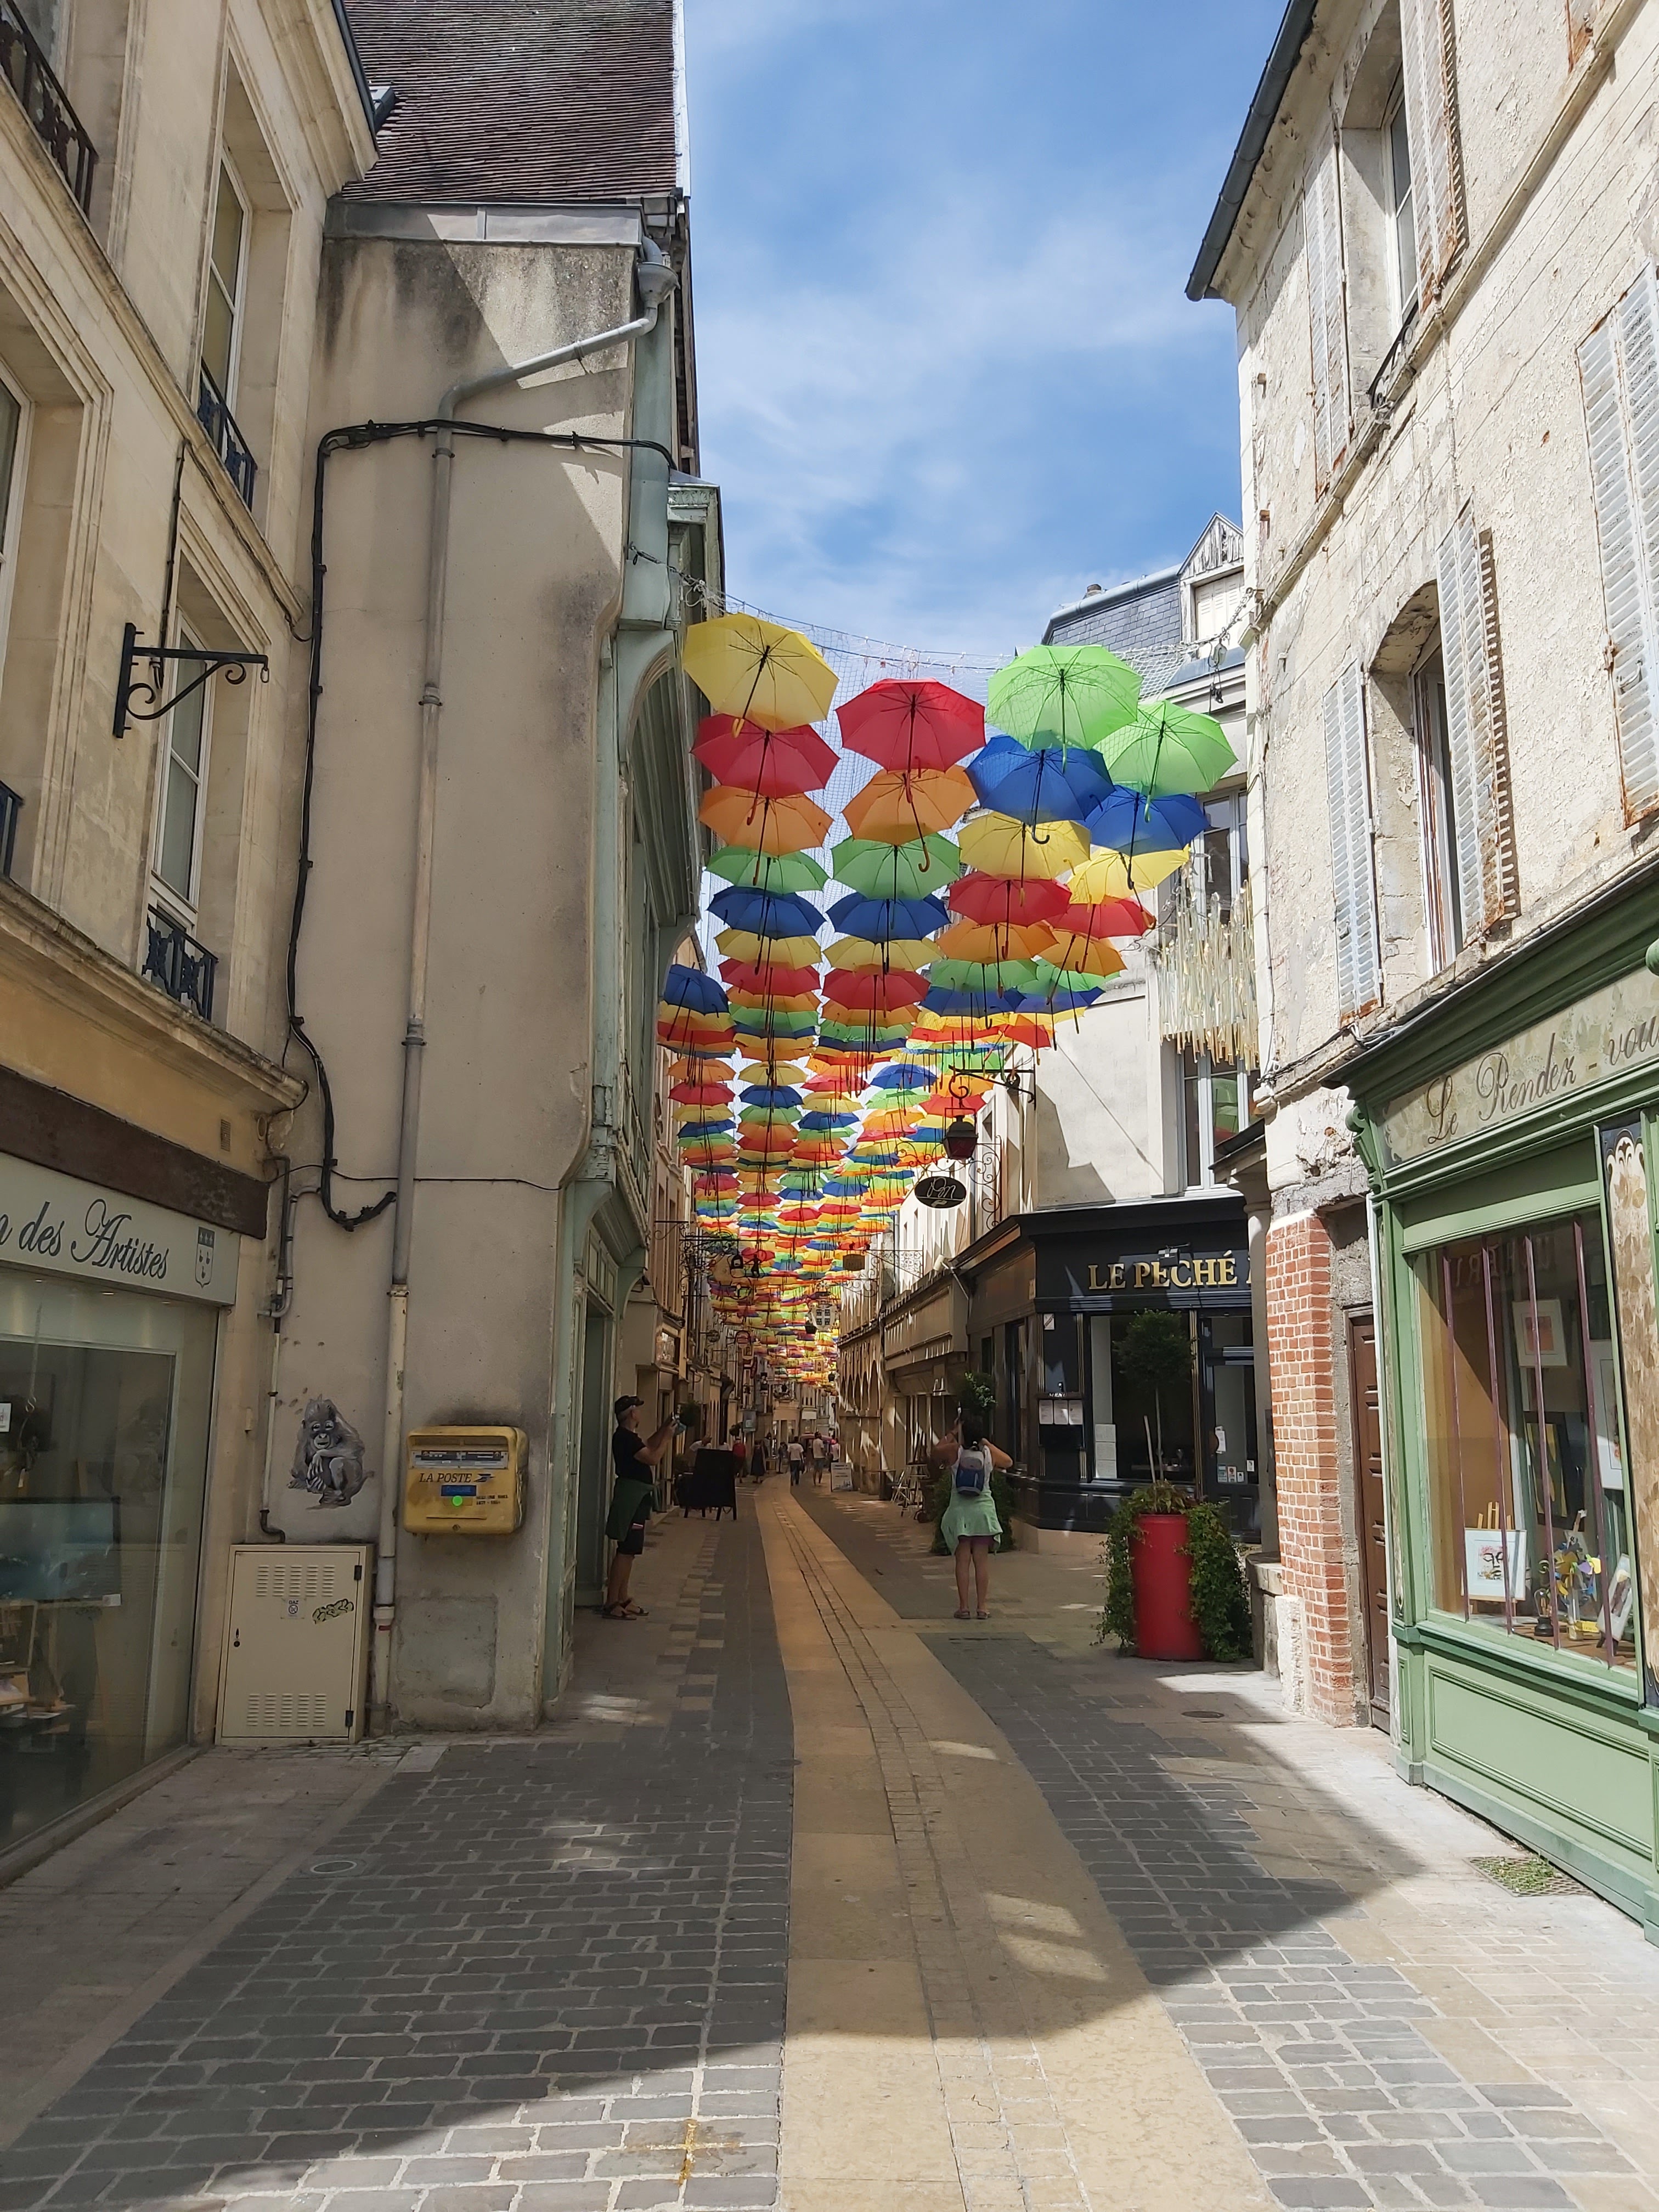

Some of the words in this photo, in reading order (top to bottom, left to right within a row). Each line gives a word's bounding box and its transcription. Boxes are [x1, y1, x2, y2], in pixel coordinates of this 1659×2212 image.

[1427, 1075, 1459, 1144] Le
[18, 1200, 65, 1257] des
[71, 1198, 170, 1279] Artistes
[1088, 1262, 1127, 1290] LE
[419, 1473, 433, 1483] LA
[437, 1472, 472, 1483] POSTE
